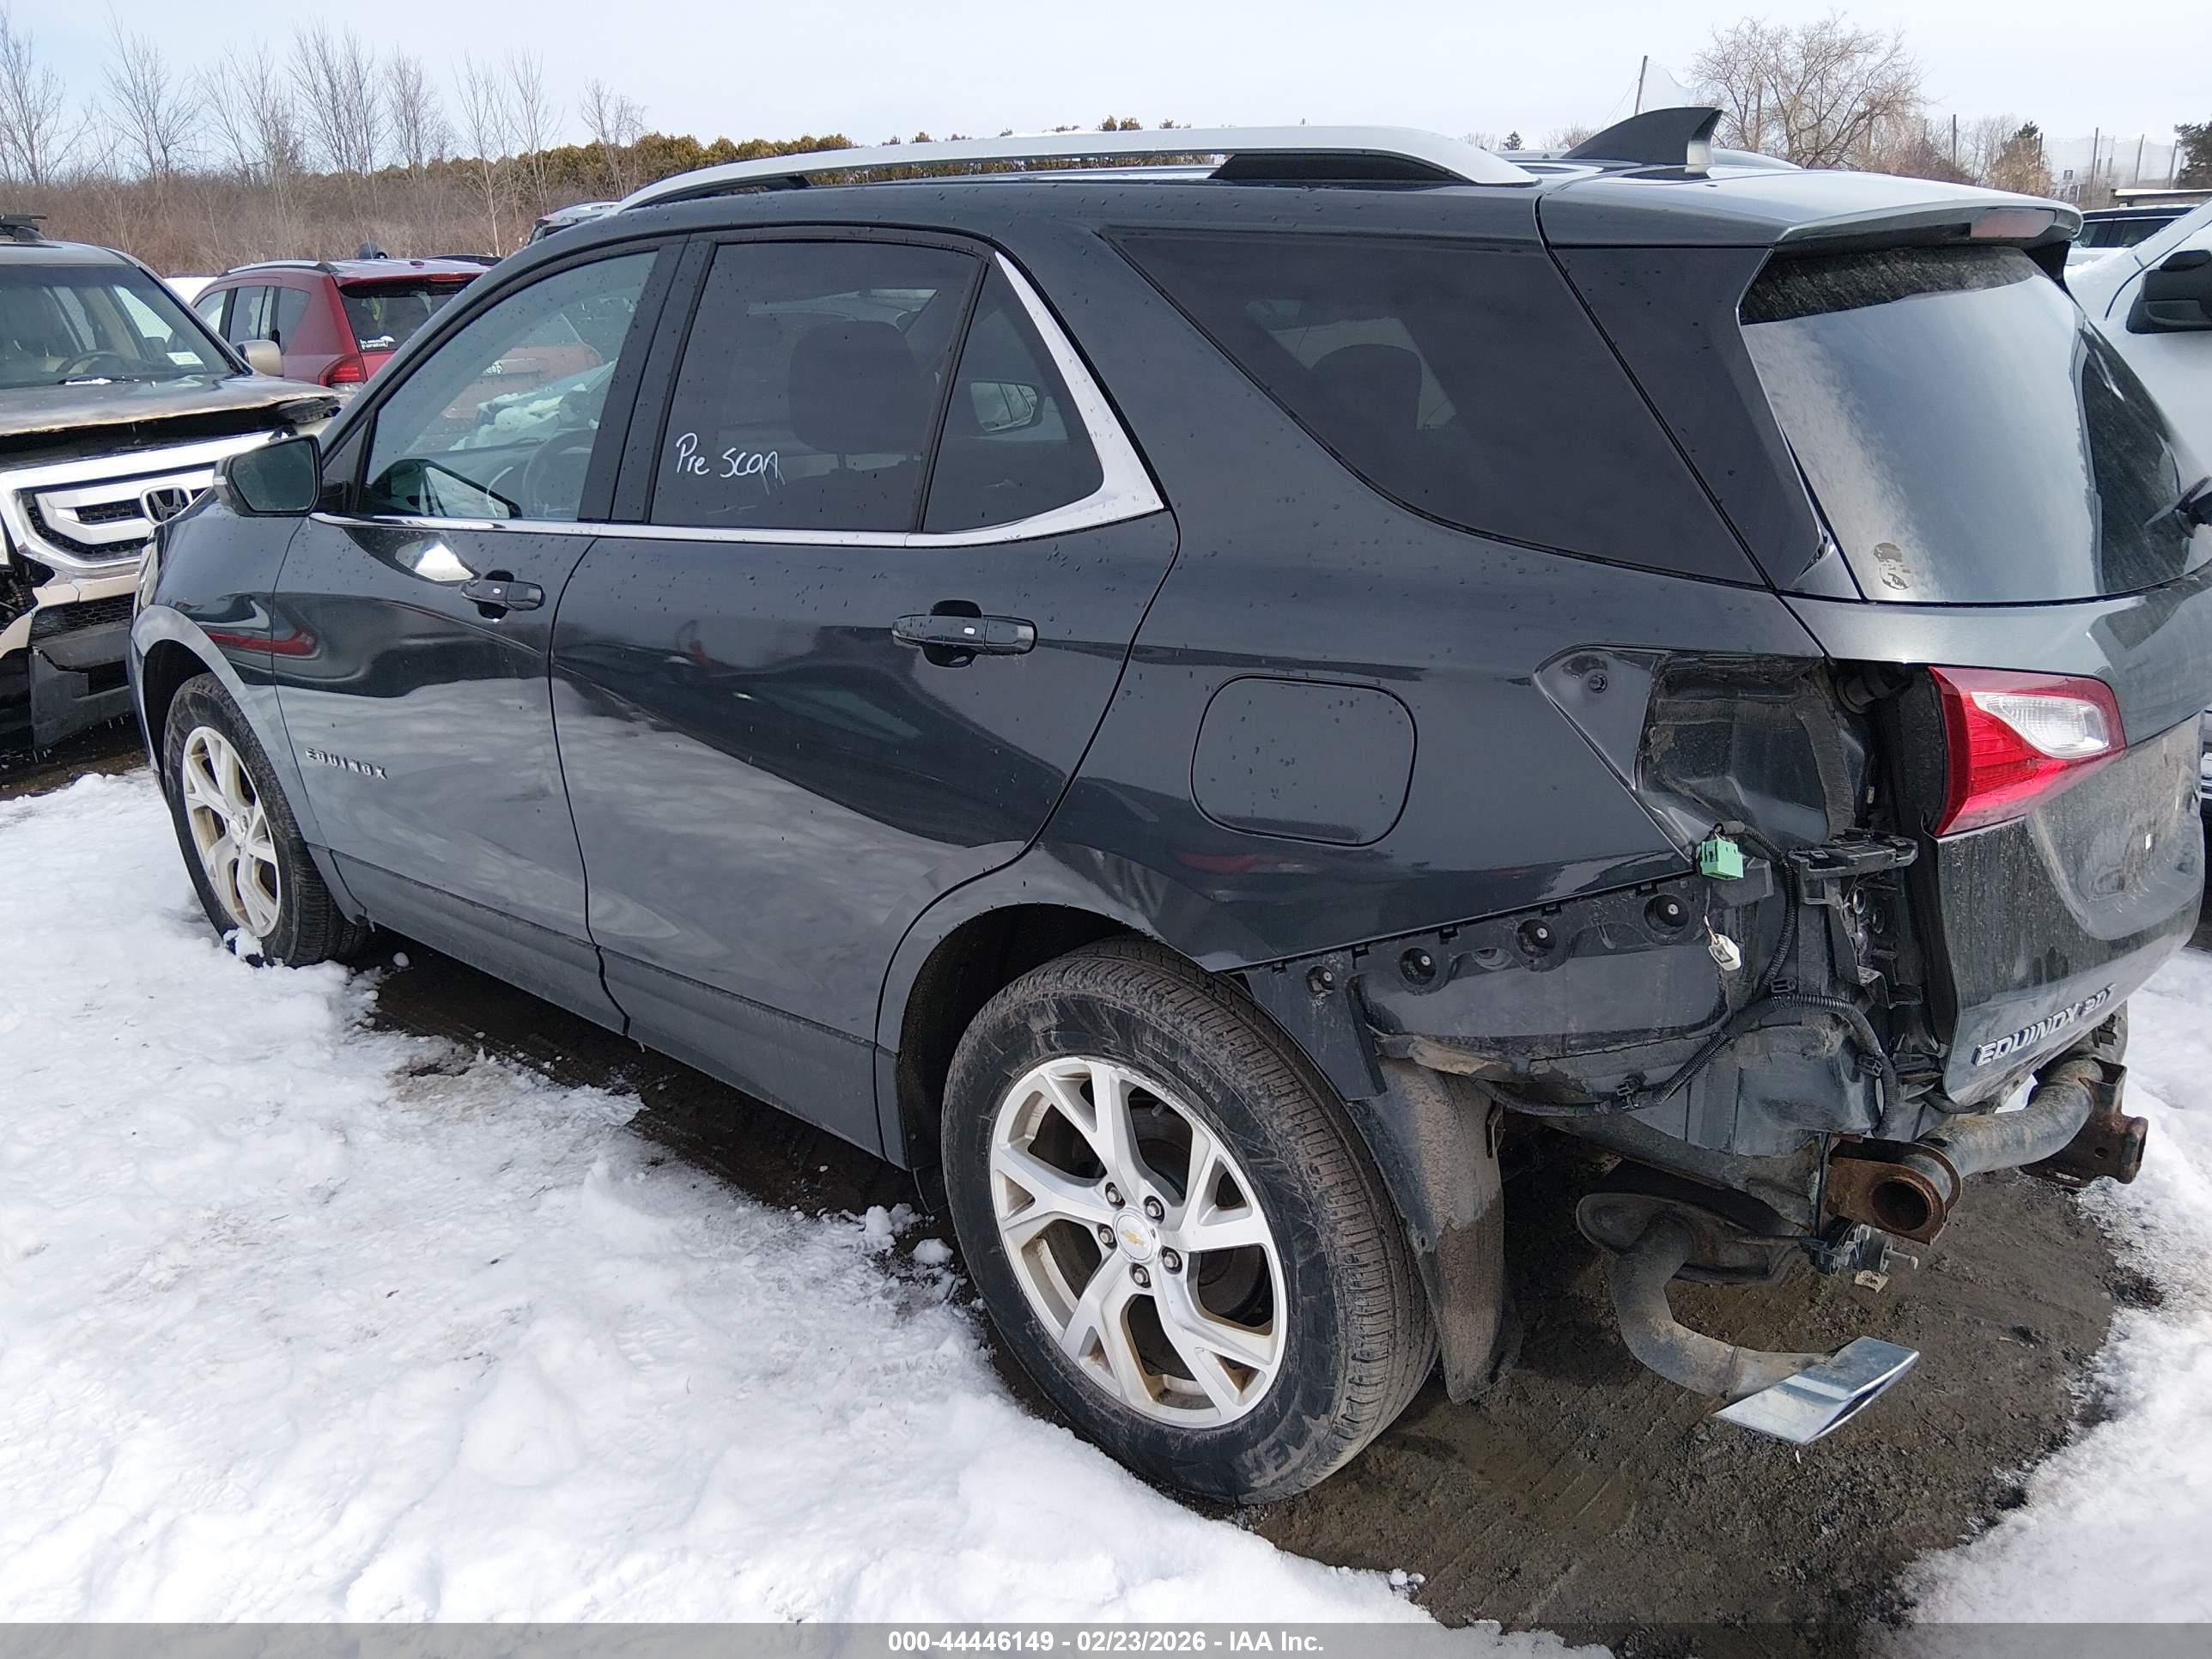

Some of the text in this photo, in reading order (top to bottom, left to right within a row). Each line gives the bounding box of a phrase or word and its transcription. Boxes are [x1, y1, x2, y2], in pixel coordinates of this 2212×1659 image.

[675, 432, 710, 475] Pre
[304, 746, 389, 781] EQUINOX
[1971, 1002, 2081, 1066] EQUINOX
